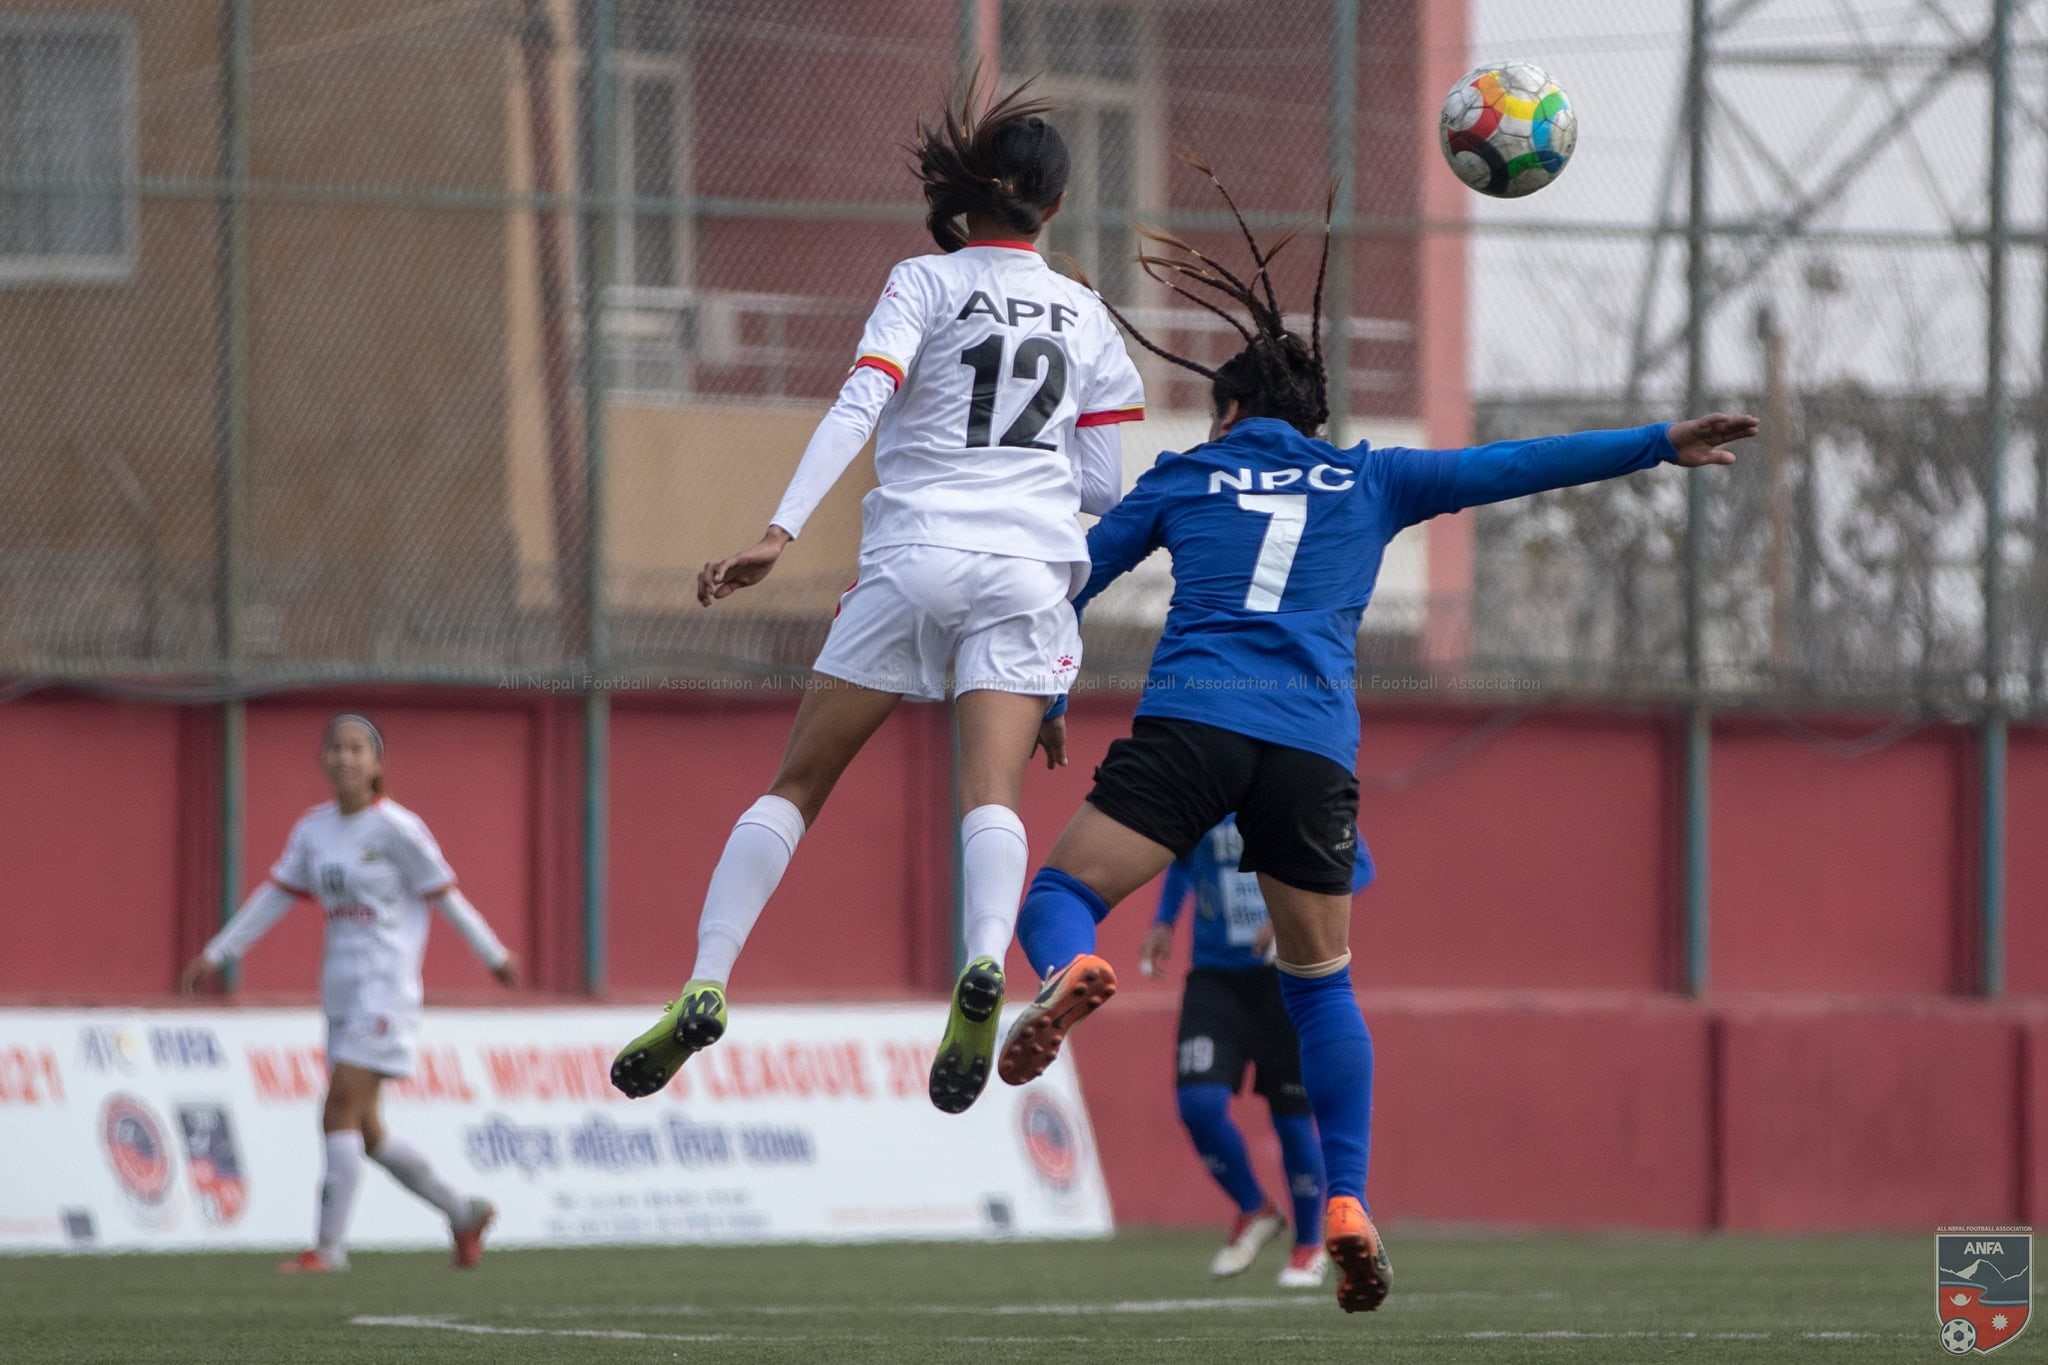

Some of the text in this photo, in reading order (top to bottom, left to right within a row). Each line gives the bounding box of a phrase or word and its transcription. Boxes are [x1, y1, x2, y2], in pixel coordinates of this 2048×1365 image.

[957, 290, 1080, 332] APF
[961, 333, 1068, 452] 12
[1208, 464, 1356, 494] NPC
[1238, 494, 1308, 612] 7
